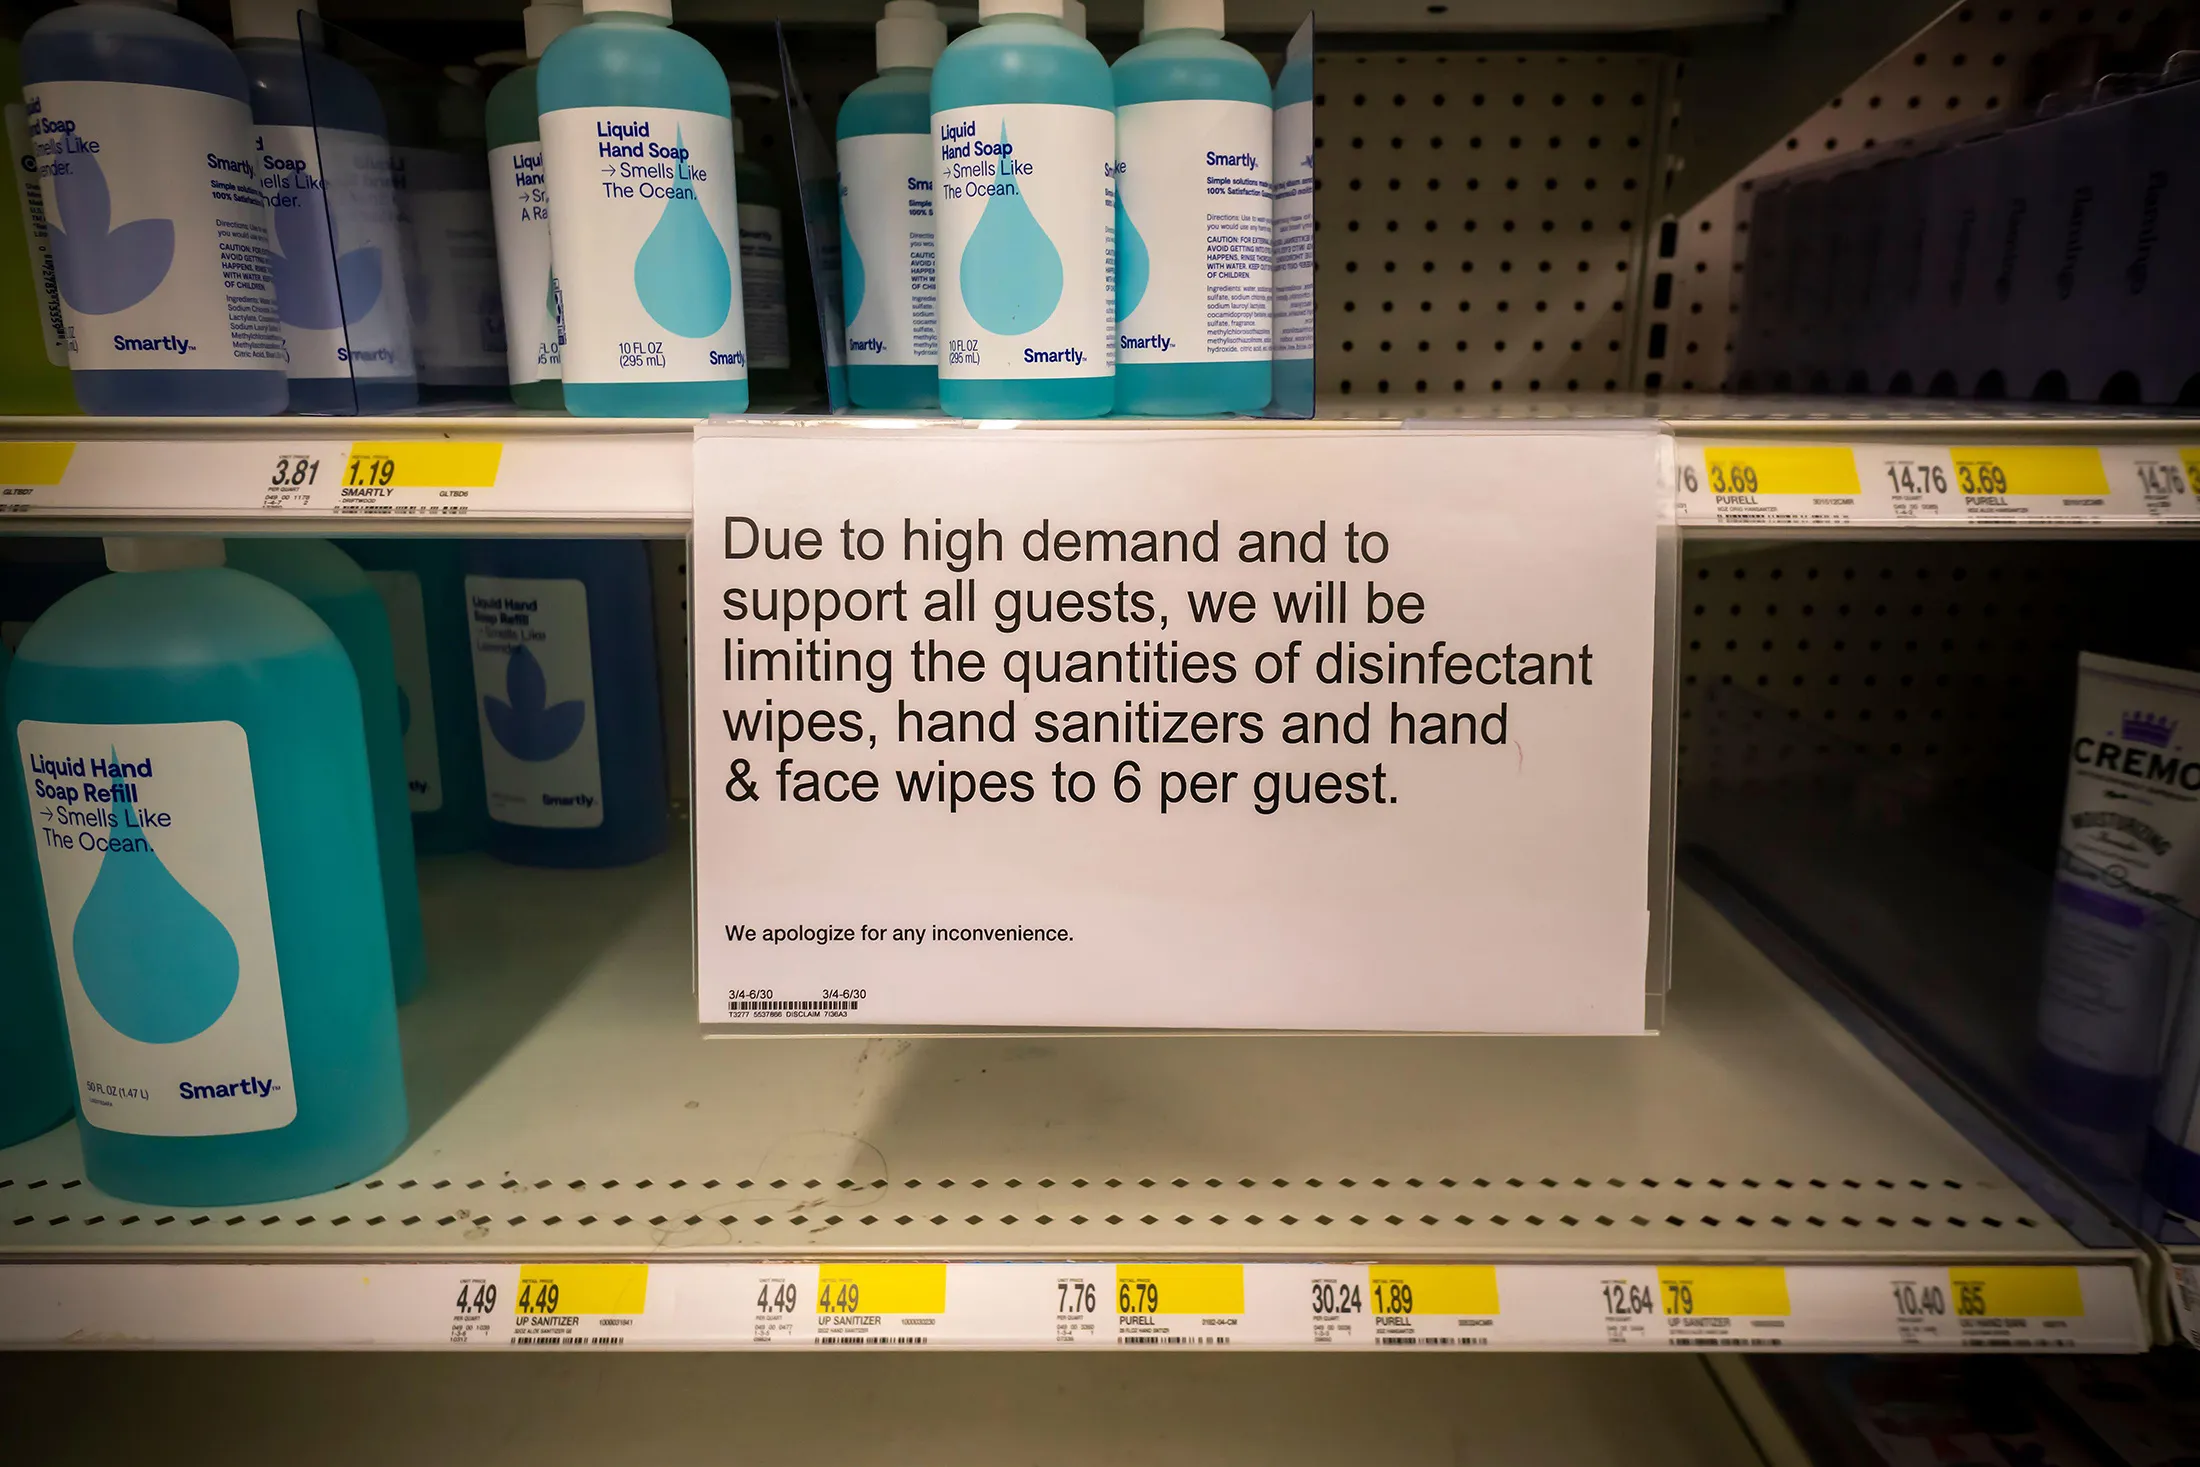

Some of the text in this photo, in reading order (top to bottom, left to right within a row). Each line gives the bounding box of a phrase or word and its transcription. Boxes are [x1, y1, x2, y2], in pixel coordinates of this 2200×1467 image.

[42, 117, 76, 136] Soap
[597, 121, 650, 141] Liquid
[941, 121, 976, 142] Liquid
[66, 137, 100, 154] Like
[599, 142, 690, 161] Hand Soap
[942, 141, 1013, 160] Hand Soap
[263, 155, 307, 173] Soap
[513, 153, 543, 171] Liqui
[620, 161, 708, 182] Smells Like
[953, 159, 1033, 179] Smells Like
[603, 182, 697, 200] The Ocean.
[944, 184, 962, 200] The
[965, 181, 1019, 198] Ocean.
[1206, 177, 1231, 186] Simple
[1206, 187, 1226, 195] 100%
[1230, 245, 1254, 253] GETTING
[619, 342, 663, 354] 10 FL OZ
[949, 340, 978, 352] 10 FL OZ
[619, 355, 666, 368] (295 mL)
[272, 459, 320, 486] 3.81
[350, 459, 395, 486] 1.19
[1711, 466, 1758, 493] 3.69
[1887, 465, 1948, 494] 14.76
[1958, 466, 2007, 494] 3.69
[341, 487, 394, 497] SMARTLY
[1716, 496, 1758, 505] PURELL
[1965, 496, 2007, 506] PURELL
[726, 517, 1388, 572] Due to high demand and to
[504, 599, 537, 611] Hand
[724, 579, 1424, 633] support all guests, we will be
[725, 638, 1593, 693] limiting the quantities of disinfectant
[723, 699, 1507, 752] wipes, hand sanitizers and hand
[30, 754, 153, 779] Liquid Hand
[2073, 736, 2200, 792] CREMO
[35, 779, 138, 805] Soap Refill
[726, 759, 1397, 814] & face wipes to 6 per guest.
[57, 805, 172, 828] Smells Like
[42, 827, 155, 853] The Ocean.
[724, 924, 1074, 946] We apologize for any inconvenience.
[728, 989, 773, 1000] 3/4-6/30
[822, 988, 867, 1000] 3/4-6/30
[785, 1010, 821, 1018] DISCLAIM
[86, 1080, 96, 1093] 50
[106, 1085, 117, 1097] OZ
[140, 1089, 149, 1101] L)
[456, 1284, 497, 1314] 4.49
[518, 1284, 559, 1314] 4.49
[757, 1283, 797, 1313] 4.49
[819, 1283, 859, 1313] 4.49
[1057, 1283, 1096, 1313] 7.76
[1119, 1283, 1158, 1313] 6.79
[1312, 1284, 1362, 1314] 30.24
[1374, 1284, 1413, 1314] 1.89
[1602, 1285, 1653, 1314] 12.64
[1666, 1285, 1693, 1314] .79
[1893, 1285, 1945, 1315] 10.40
[516, 1316, 579, 1326] UP SANITIZER
[818, 1316, 881, 1326] UP SANITIZER
[1119, 1316, 1155, 1326] PURELL
[1375, 1316, 1411, 1326] PURELL
[1667, 1317, 1731, 1327] UP SANITIZER
